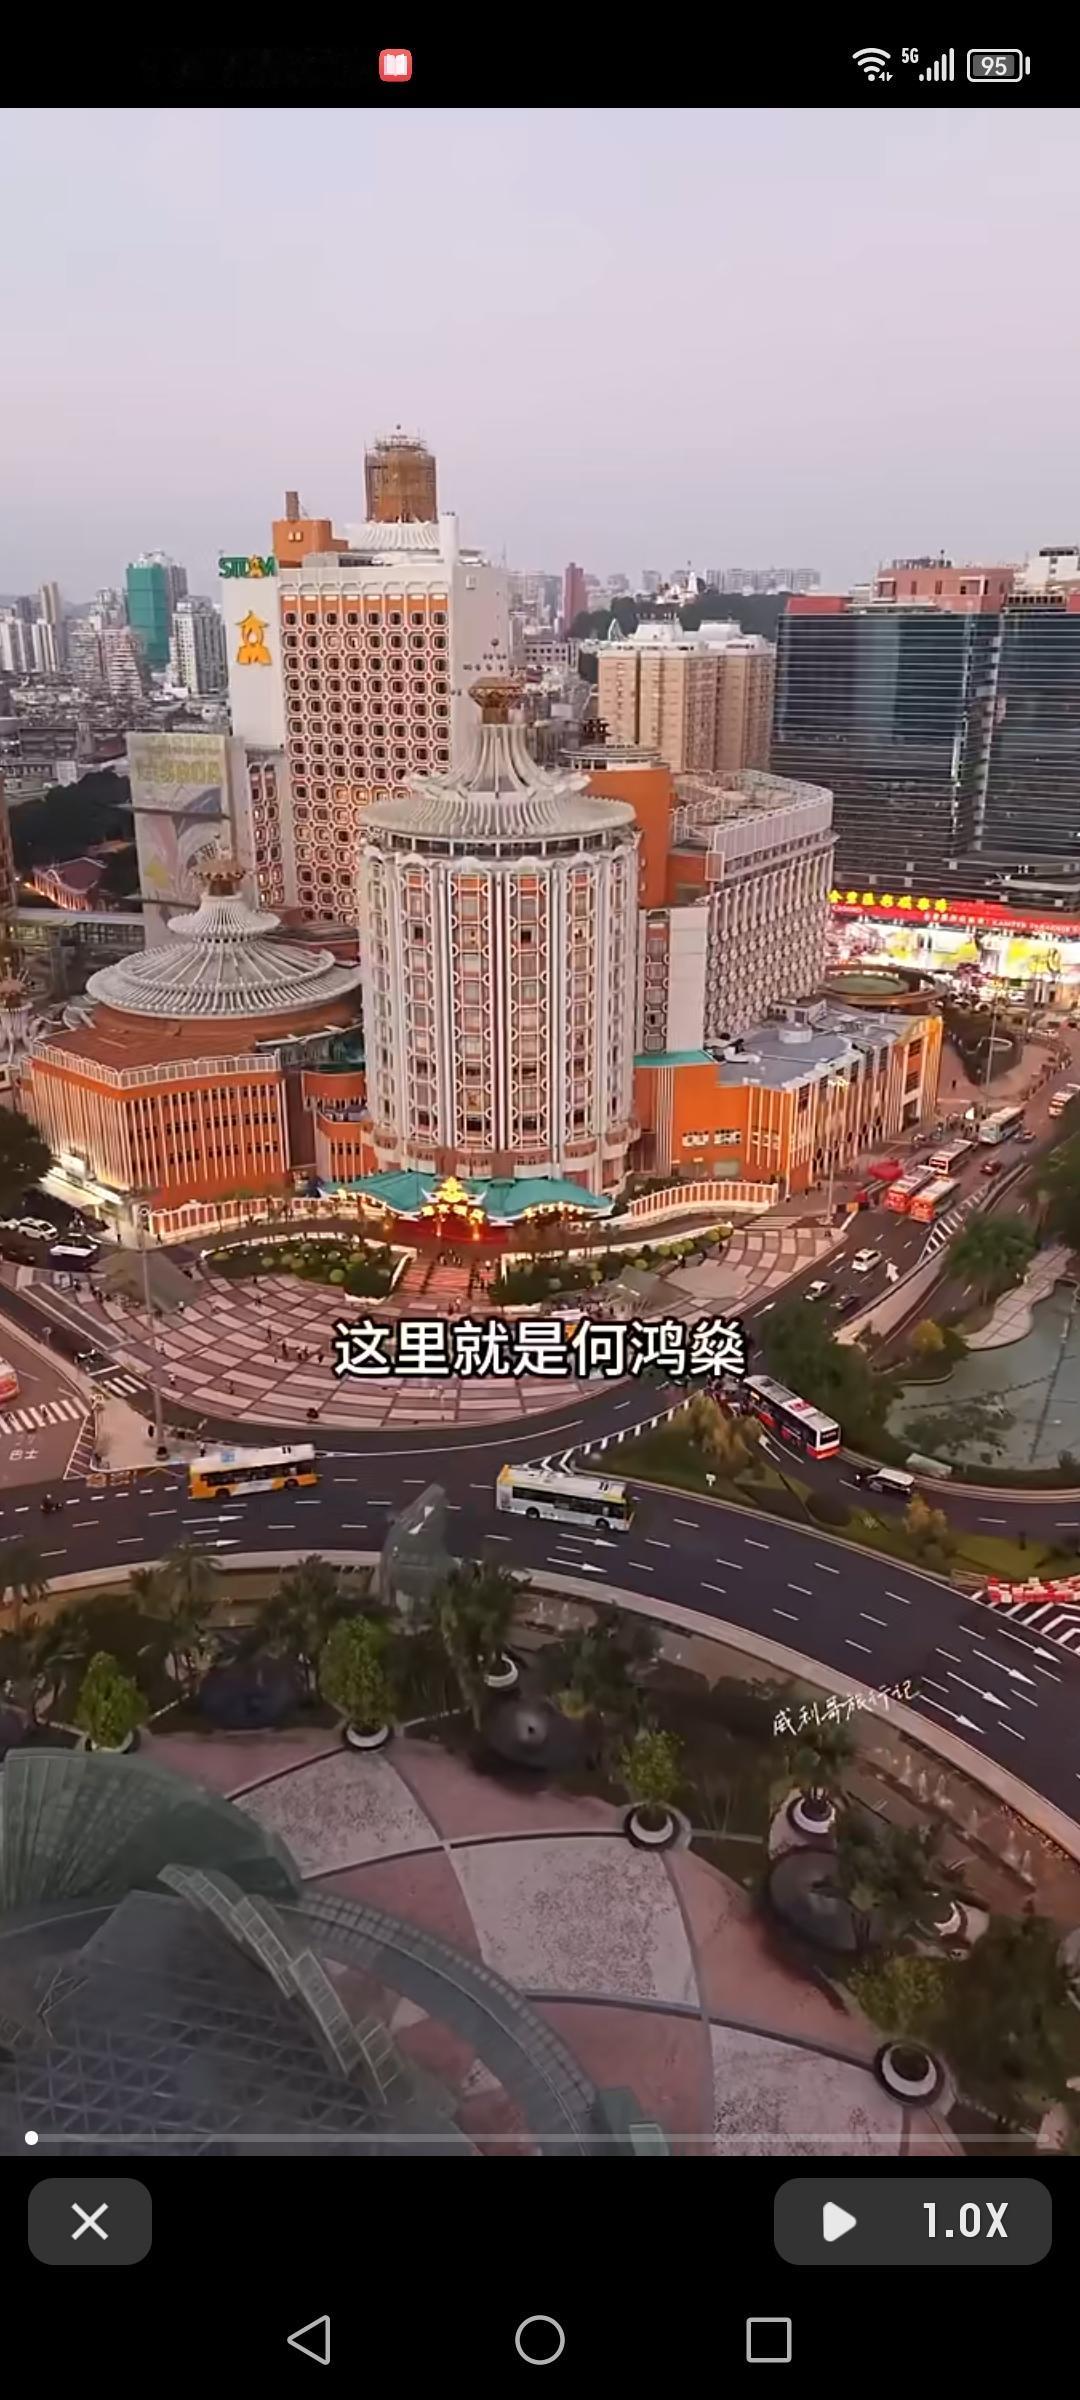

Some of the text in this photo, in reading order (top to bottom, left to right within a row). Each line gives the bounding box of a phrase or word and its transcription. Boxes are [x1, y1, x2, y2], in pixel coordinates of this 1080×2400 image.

[901, 47, 919, 64] 5G
[981, 57, 1008, 76] 95
[923, 2202, 1009, 2238] 1.0X
